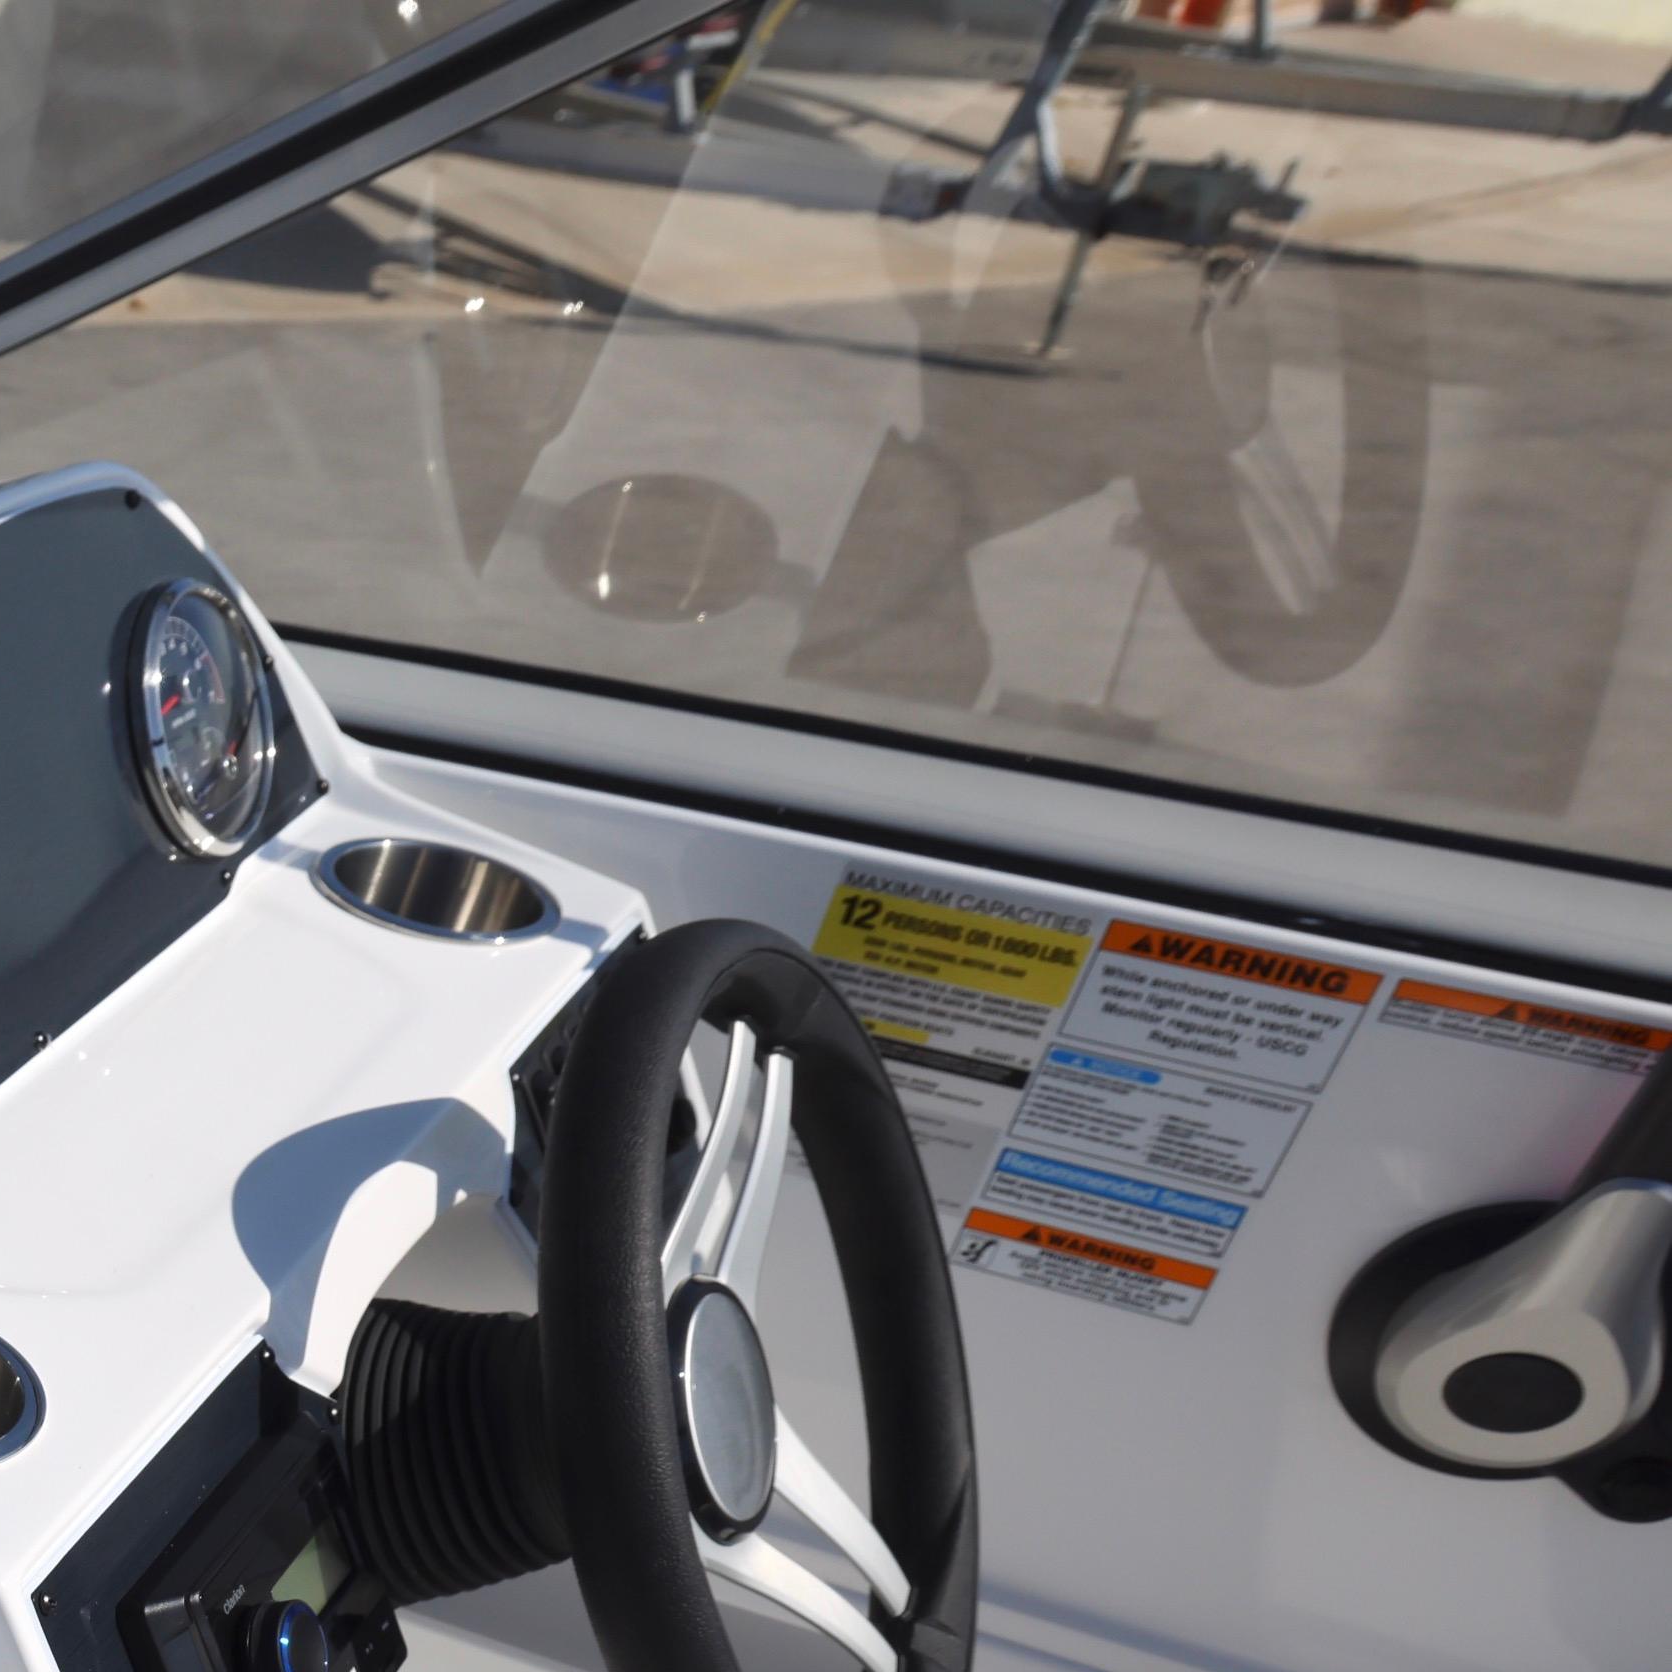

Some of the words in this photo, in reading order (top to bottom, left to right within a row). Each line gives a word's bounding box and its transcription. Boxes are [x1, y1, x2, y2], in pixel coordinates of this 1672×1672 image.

[841, 894, 883, 931] 12
[882, 911, 964, 943] PERSONS
[965, 929, 992, 947] OR
[844, 871, 953, 907] MAXIMUM
[957, 894, 1093, 936] CAPACITIES
[1159, 935, 1351, 994] WARNING
[1100, 985, 1143, 1003] stern
[1146, 992, 1185, 1013] light
[1188, 1003, 1230, 1022] must
[1232, 1010, 1254, 1027] be
[1258, 1017, 1325, 1041] vertical.
[1102, 965, 1146, 985] While
[1151, 977, 1230, 1004] anchored
[1232, 995, 1251, 1007] or
[1254, 1000, 1305, 1018] under
[1310, 1011, 1344, 1029] way
[1101, 1002, 1165, 1026] Monitor
[1167, 1016, 1243, 1045] regularly
[1256, 1036, 1309, 1057] USCG
[1148, 1030, 1239, 1060] Regulation.
[1002, 1151, 1157, 1202] Recommended
[1159, 1188, 1240, 1227] Seating
[1048, 1232, 1157, 1272] WARNING
